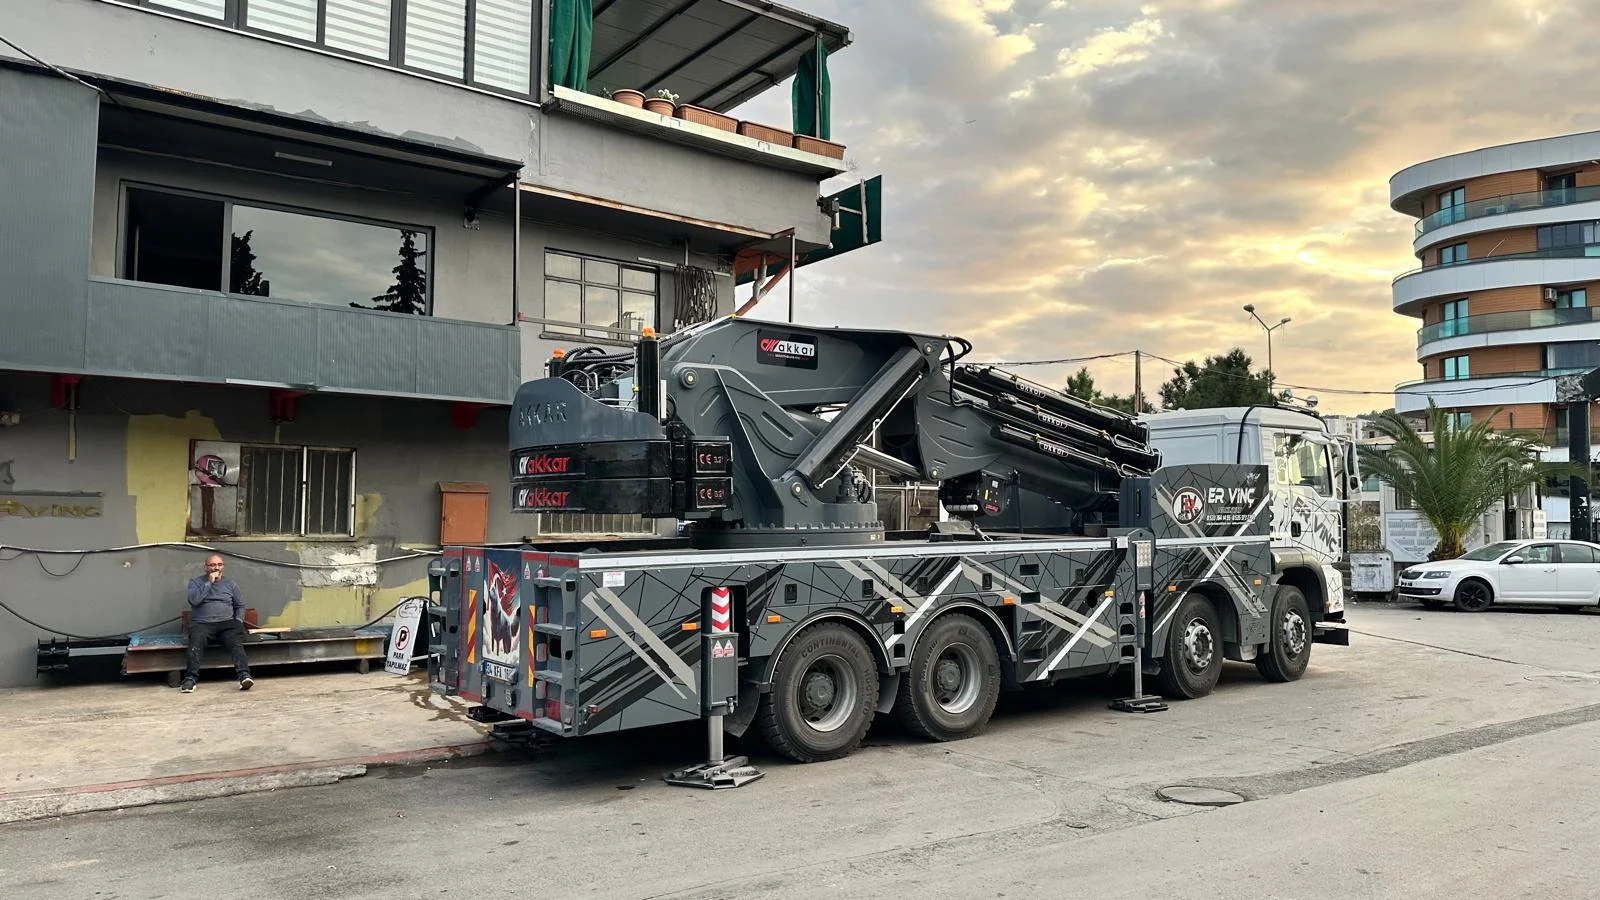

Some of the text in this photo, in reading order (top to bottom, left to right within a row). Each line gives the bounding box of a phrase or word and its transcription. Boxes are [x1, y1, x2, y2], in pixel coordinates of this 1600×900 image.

[778, 342, 813, 355] akkar
[1208, 488, 1224, 504] ER
[801, 637, 859, 659] CONTINENTAL
[387, 660, 407, 670] YAPILMAZ
